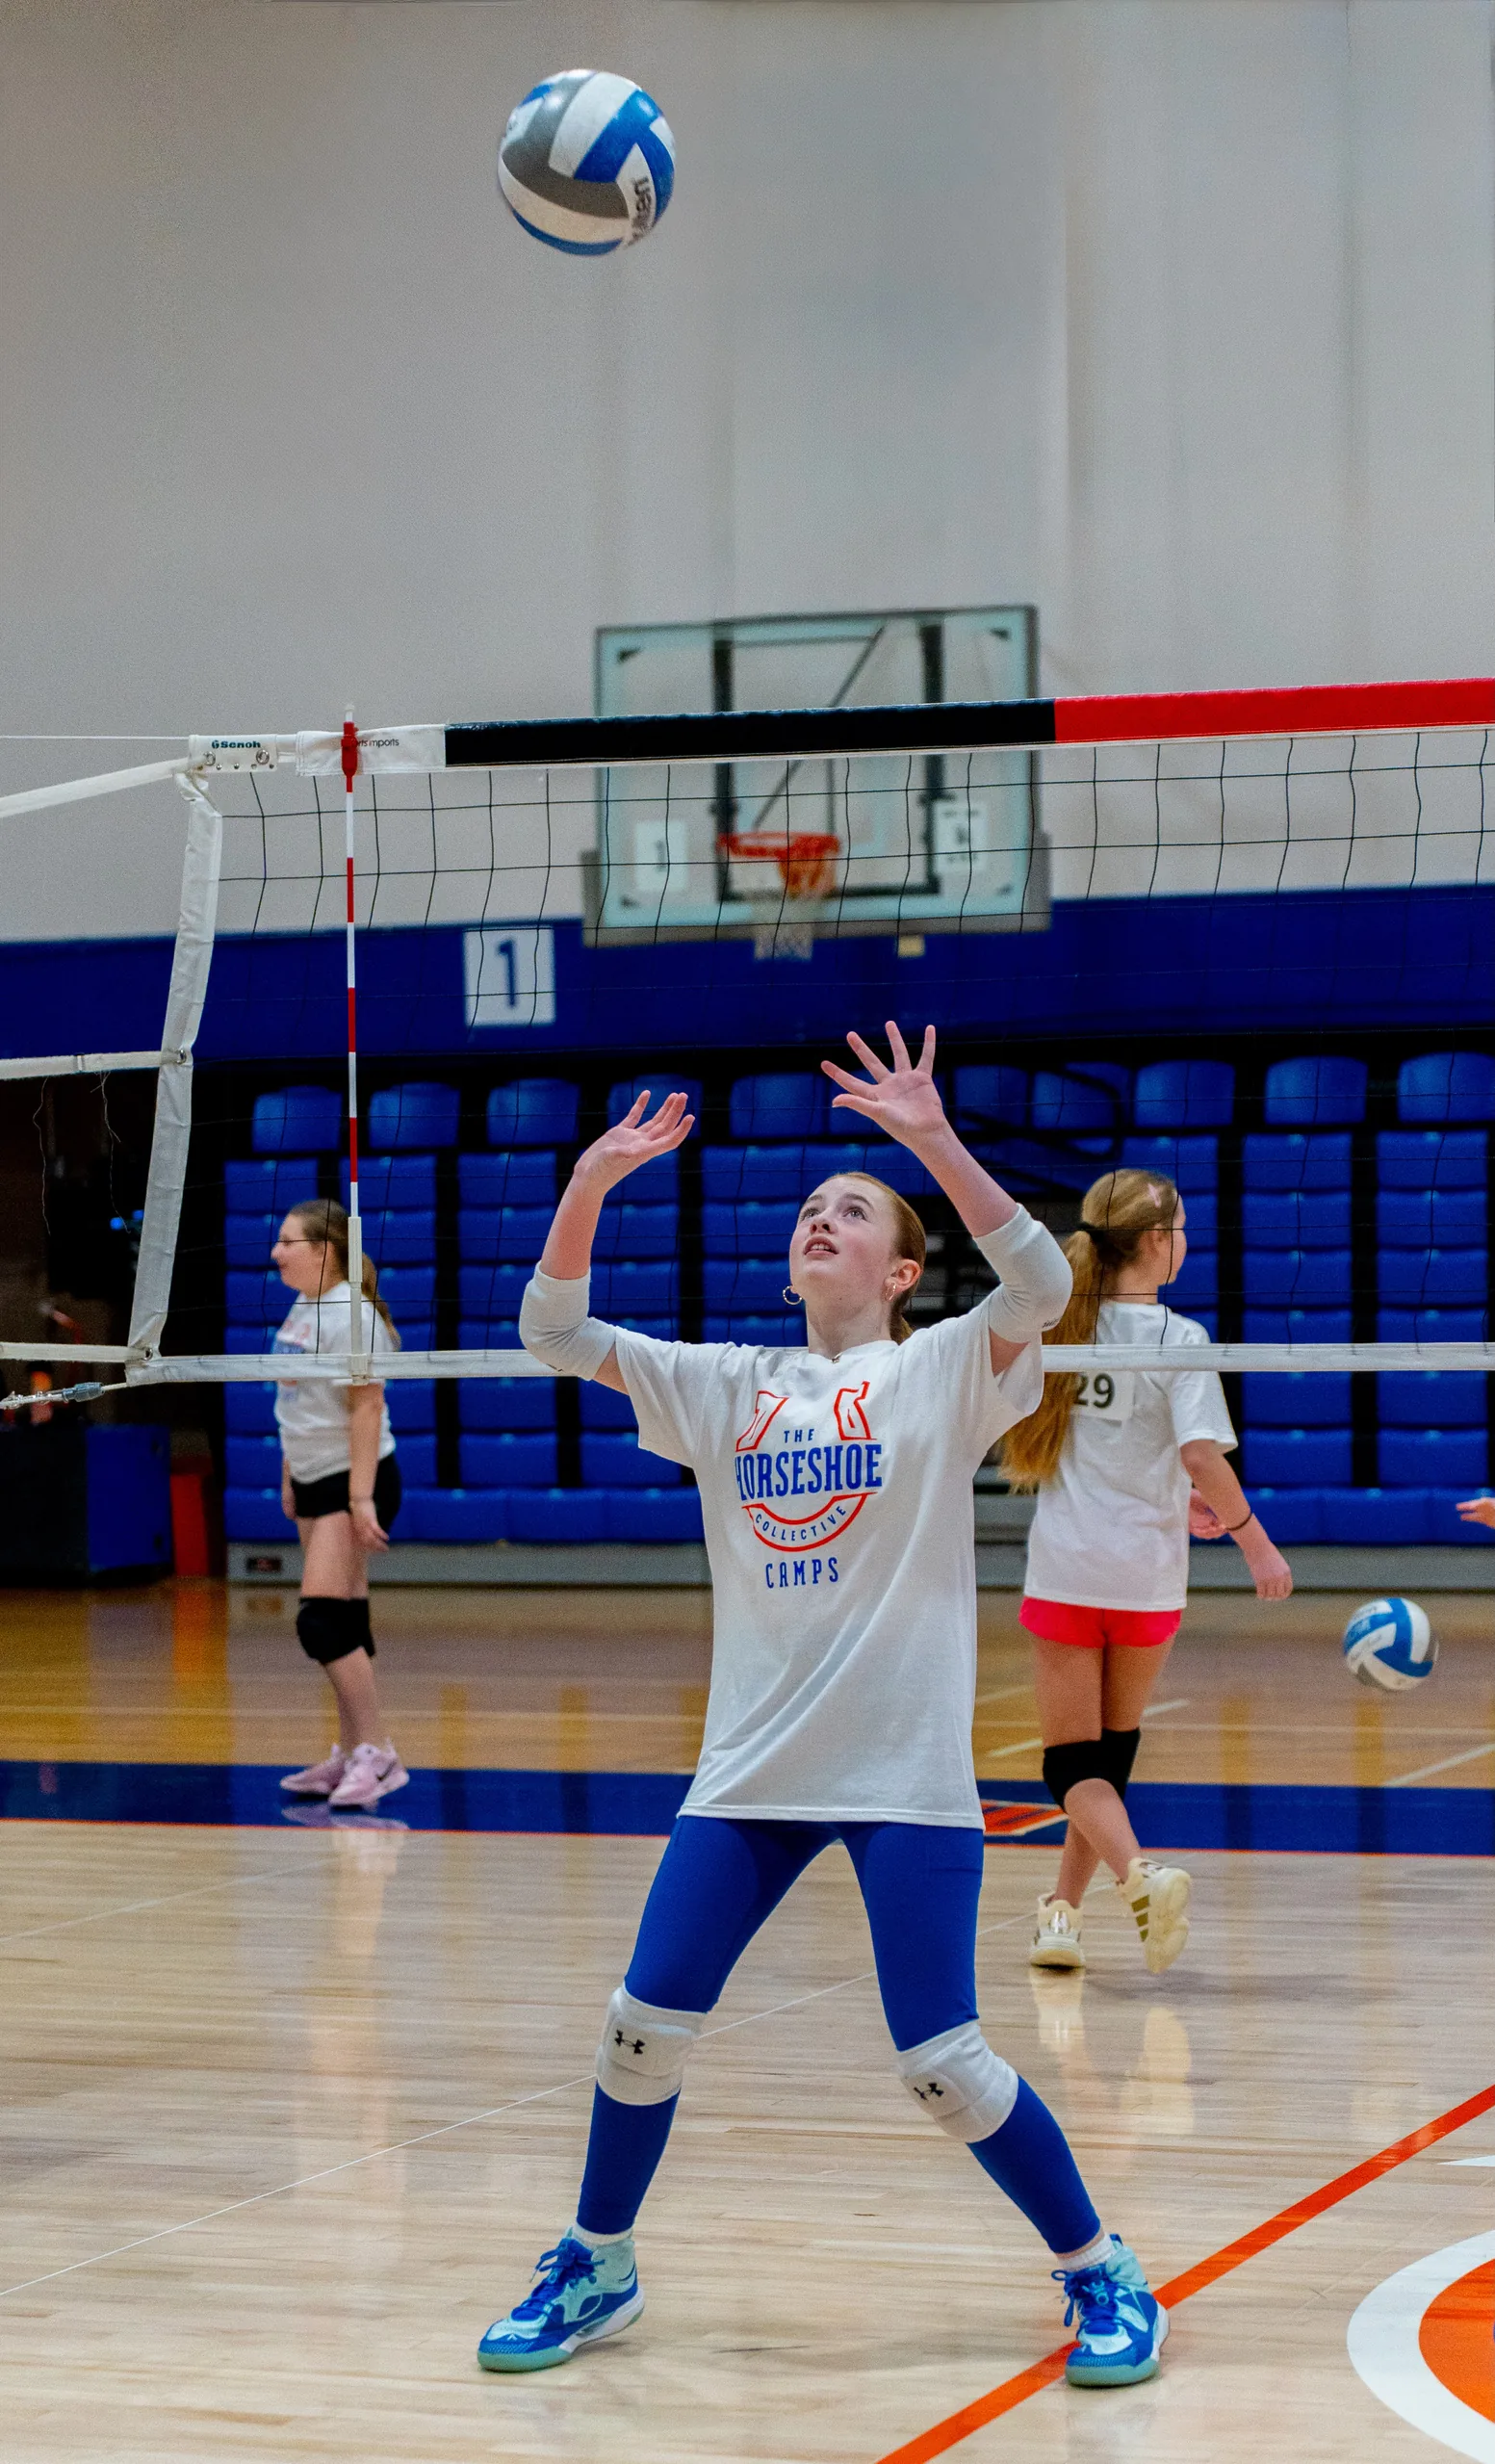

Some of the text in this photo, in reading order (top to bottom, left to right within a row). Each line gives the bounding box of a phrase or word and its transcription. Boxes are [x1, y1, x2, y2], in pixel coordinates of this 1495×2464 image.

[369, 738, 400, 748] imports
[498, 939, 516, 1007] 1
[784, 1428, 814, 1443] THE
[735, 1443, 883, 1501] HORSESHOE
[756, 1505, 846, 1542] COLLECTIVE
[765, 1557, 839, 1589] CAMPS
